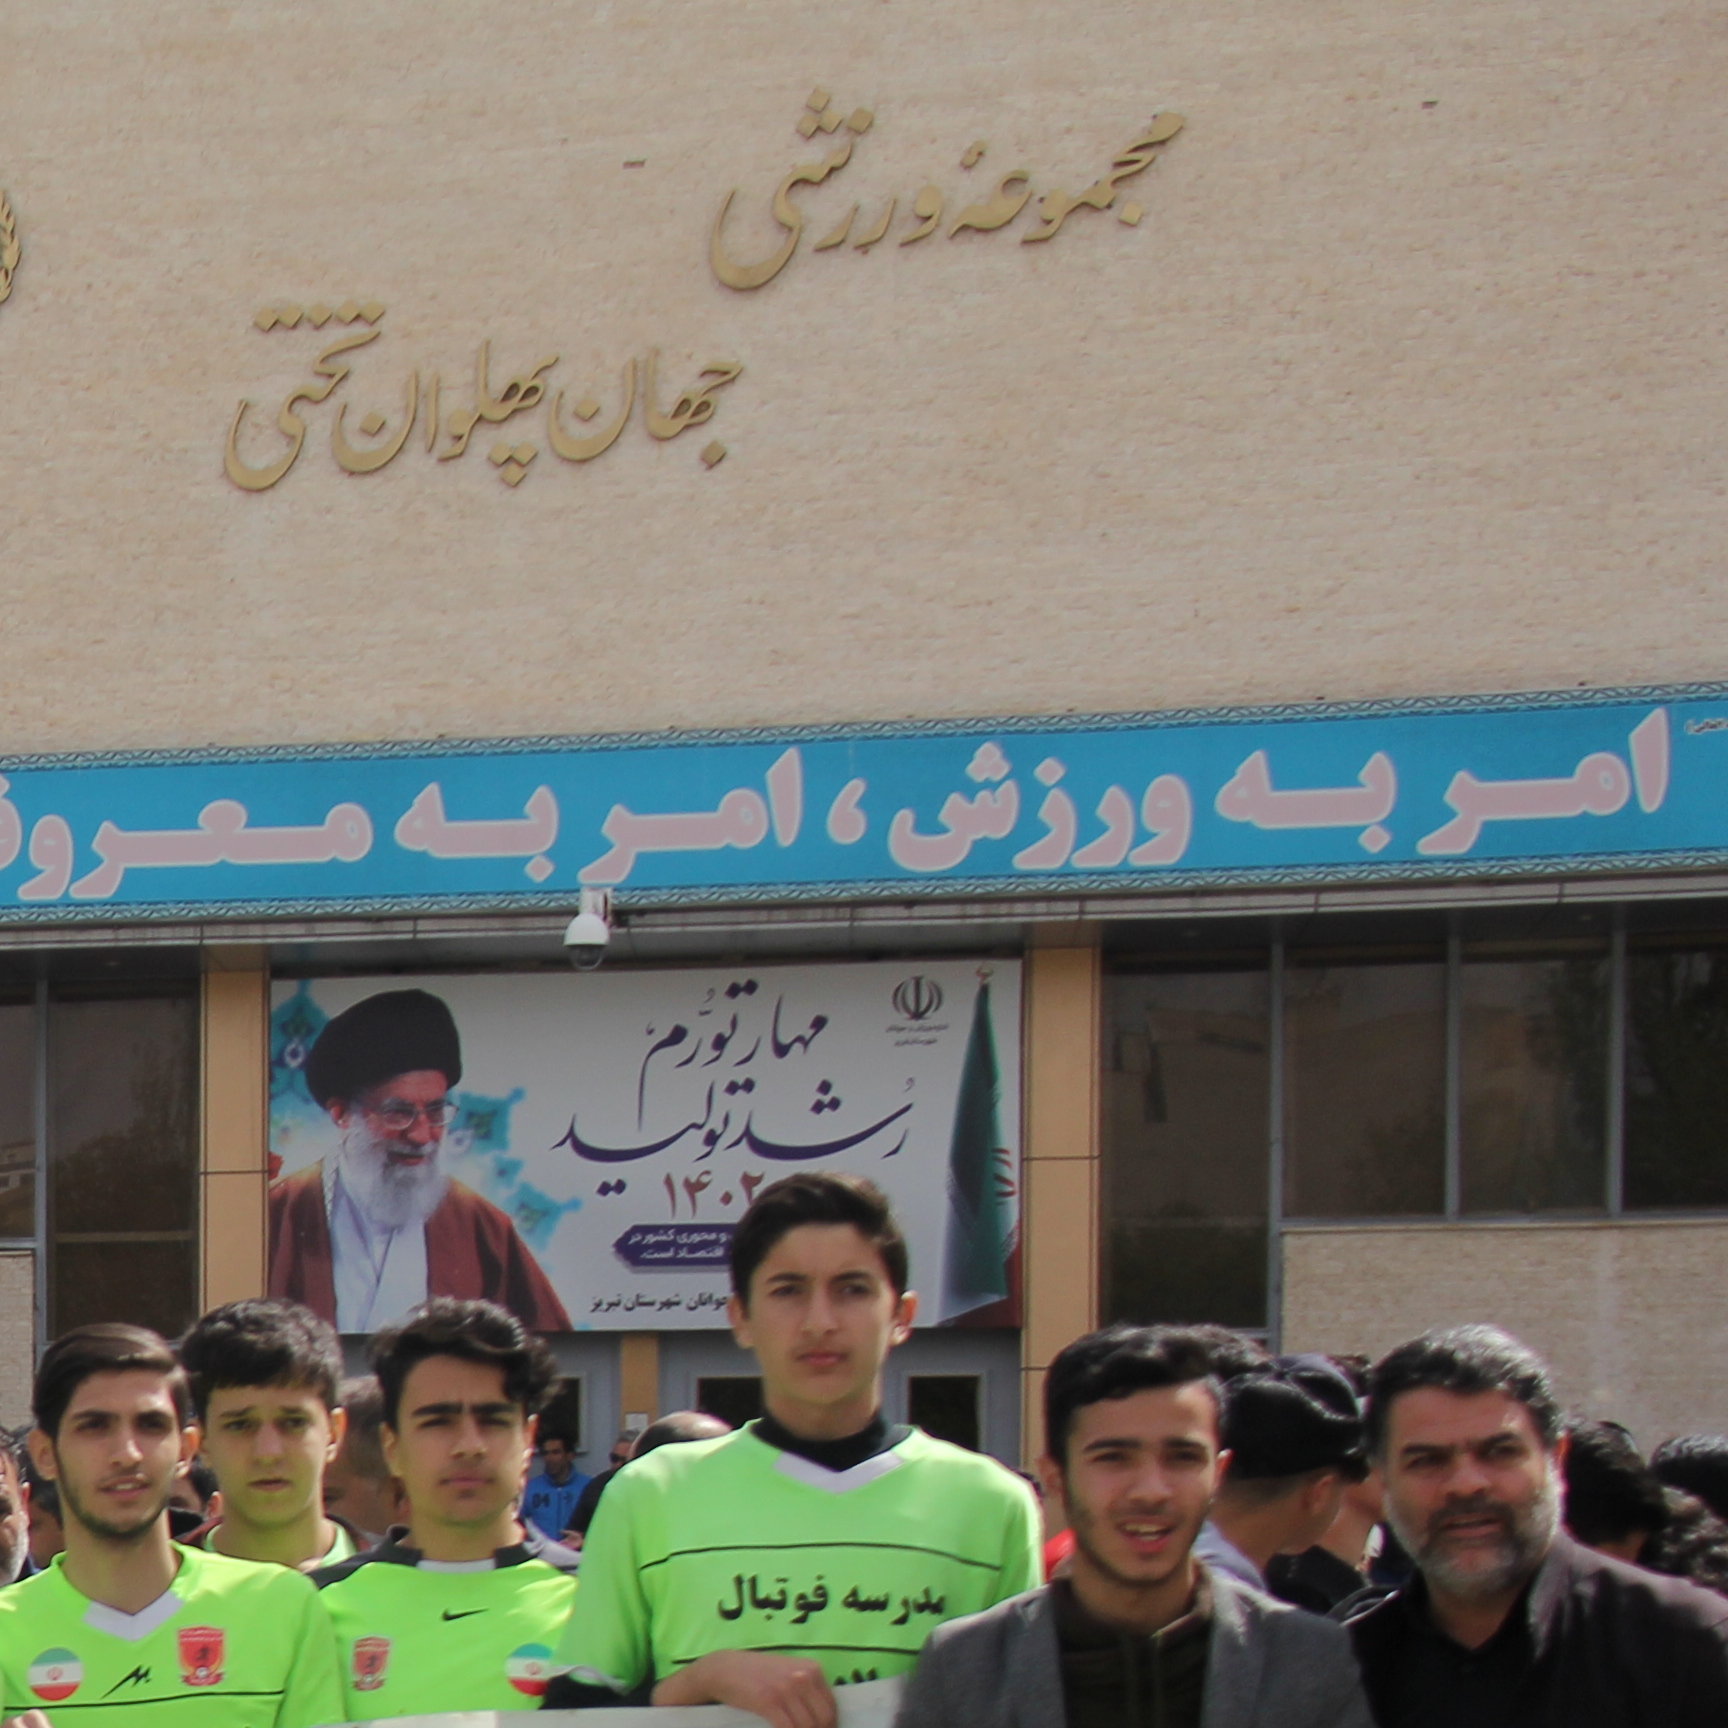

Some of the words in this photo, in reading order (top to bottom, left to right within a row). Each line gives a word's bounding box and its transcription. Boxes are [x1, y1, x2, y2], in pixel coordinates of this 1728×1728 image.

[710, 85, 943, 291] ورزشی
[224, 303, 386, 492] تختی
[332, 338, 559, 488] پهلوان
[547, 346, 744, 470] جهان
[393, 781, 559, 883] به
[578, 746, 804, 885] امر
[1214, 747, 1398, 854] به
[1416, 707, 1672, 857] امر
[733, 993, 829, 1068] مهار
[590, 1293, 622, 1313] تبریز
[623, 1292, 682, 1312] شهرستان
[717, 1573, 830, 1624] فوتبال
[843, 1585, 946, 1625] مدرسه
